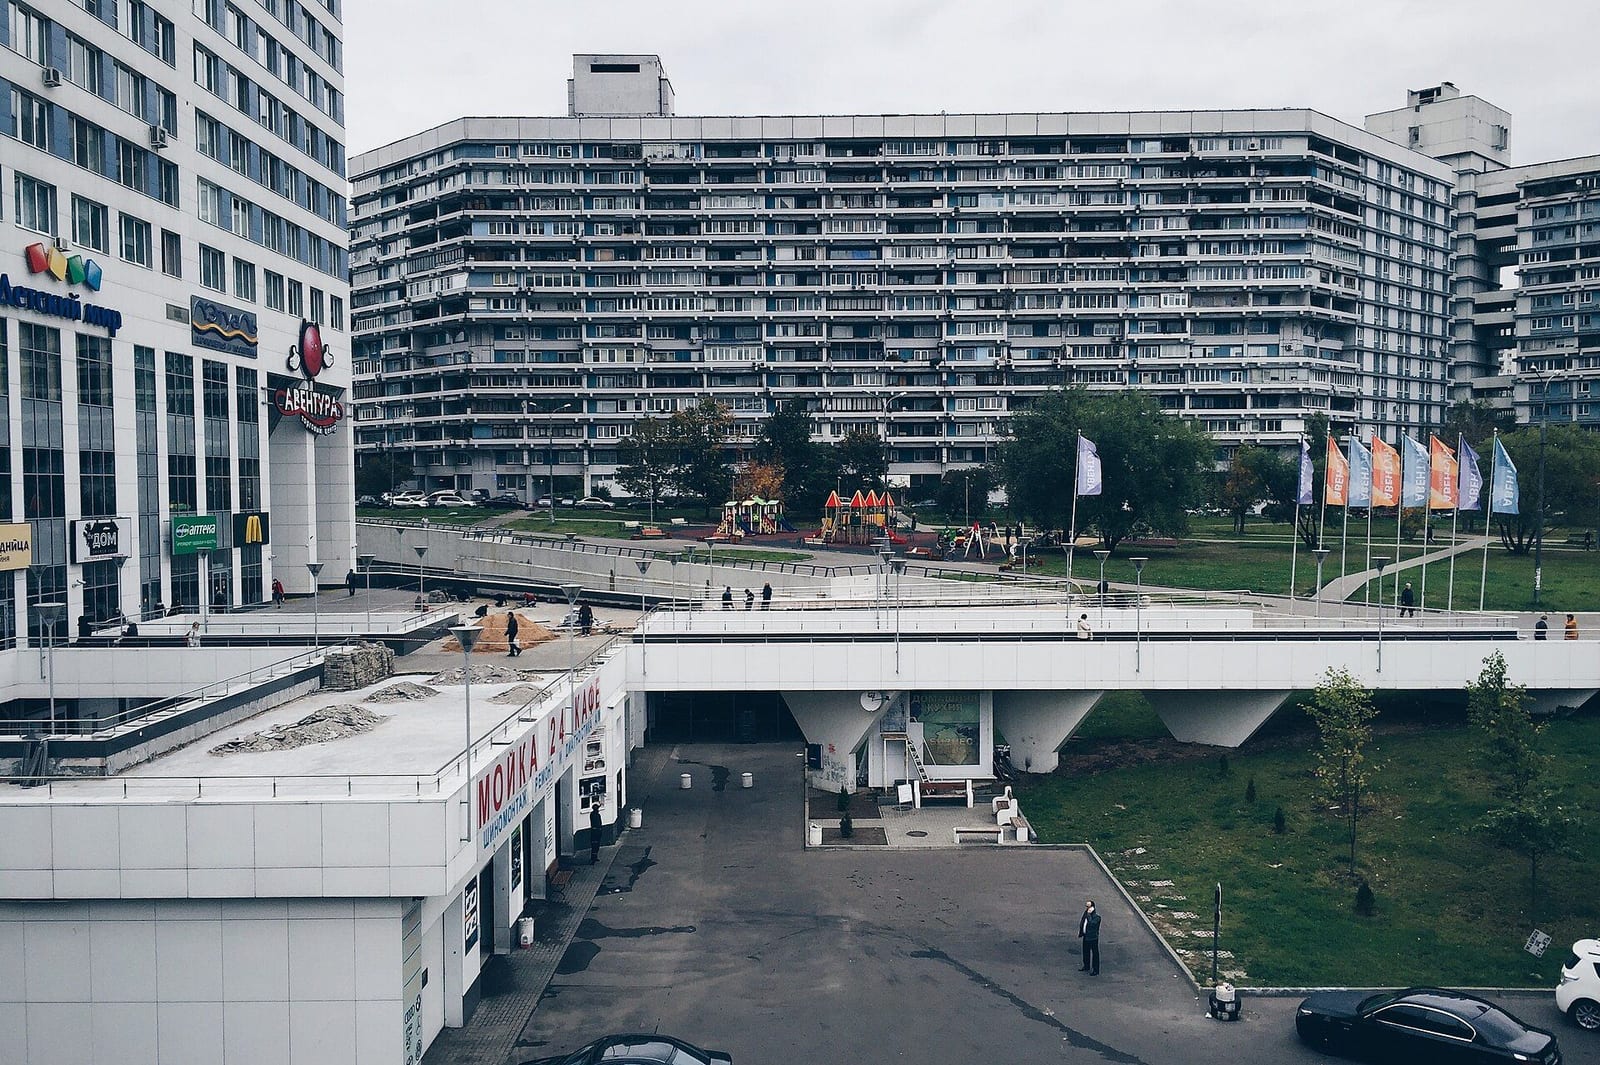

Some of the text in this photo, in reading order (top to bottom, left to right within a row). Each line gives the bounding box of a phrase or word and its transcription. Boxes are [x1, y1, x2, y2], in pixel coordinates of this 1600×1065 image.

[285, 387, 338, 417] АВЕНТУРА
[92, 532, 117, 549] ДОМ
[478, 734, 538, 830] МОЙКА
[550, 708, 565, 757] 24
[574, 677, 600, 731] КАФЕ
[482, 788, 528, 849] ШИНОМОНТАЖ
[534, 760, 555, 793] РЕМОНТ
